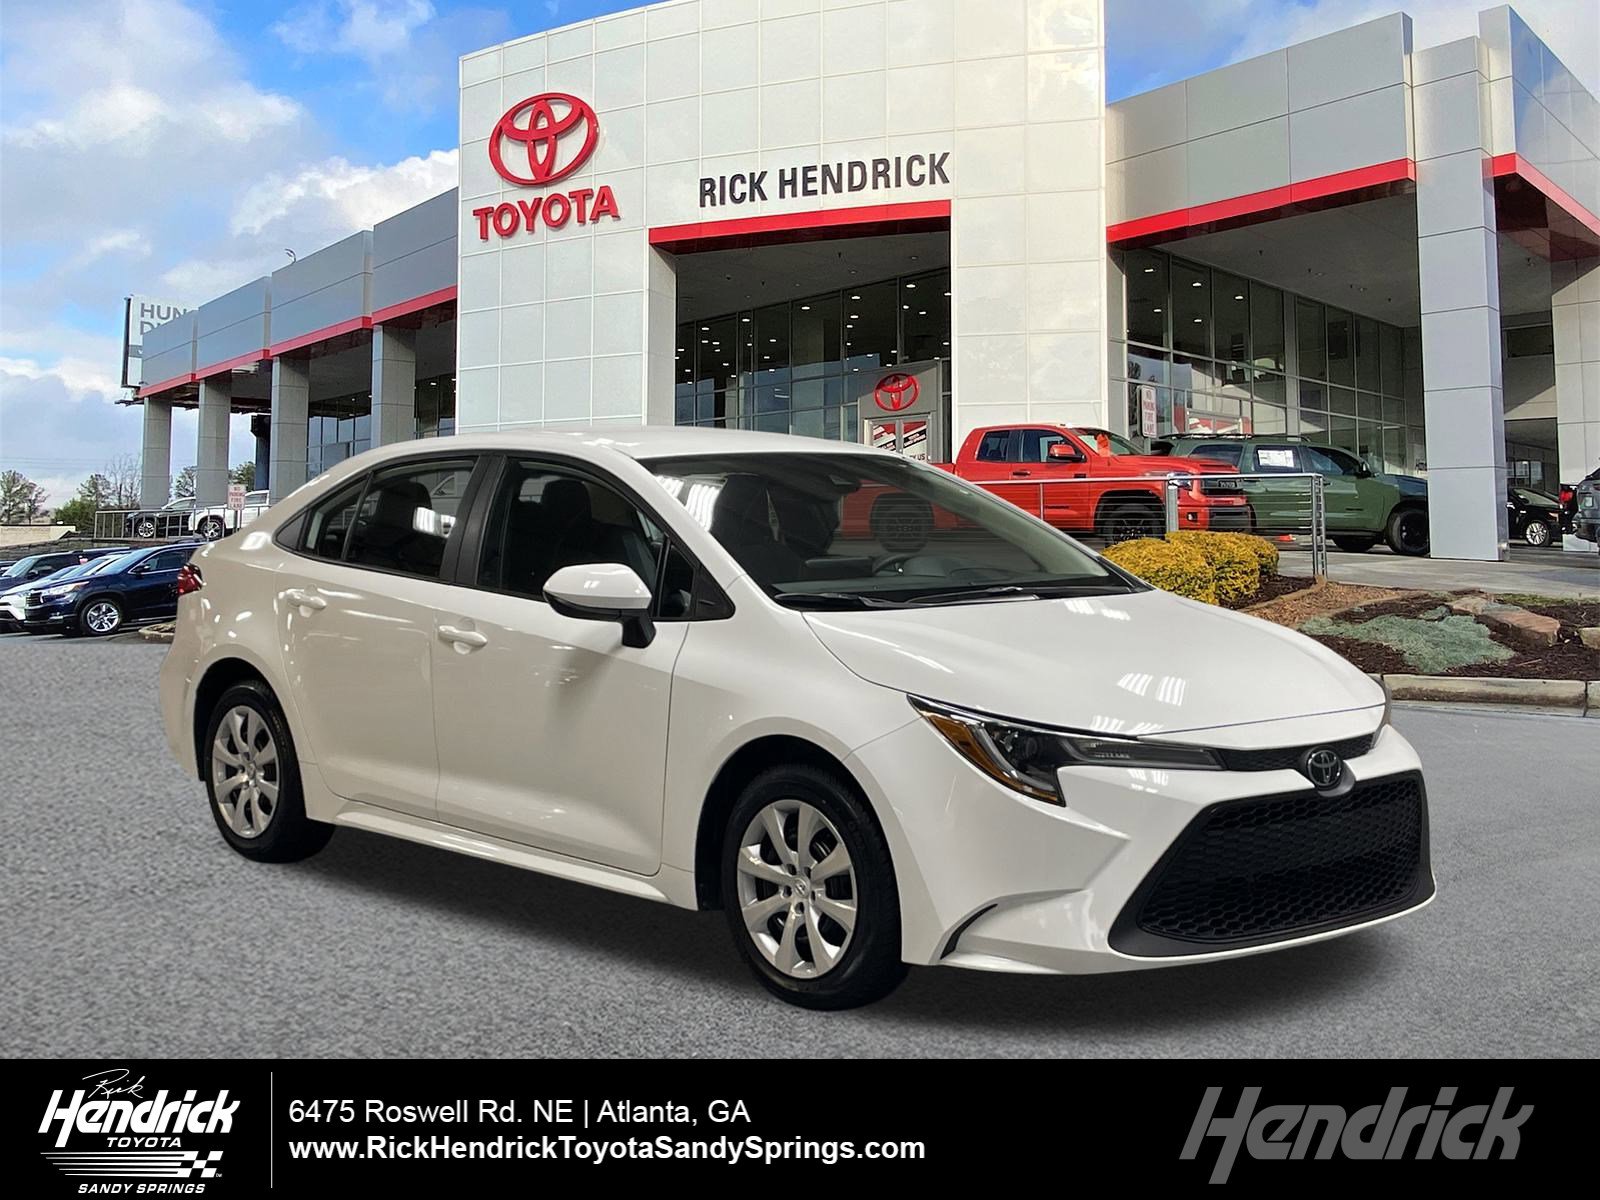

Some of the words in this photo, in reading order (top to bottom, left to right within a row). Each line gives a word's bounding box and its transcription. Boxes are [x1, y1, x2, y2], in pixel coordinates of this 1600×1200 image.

[698, 170, 768, 209] RICK
[778, 151, 951, 200] HENDRICK
[472, 184, 621, 241] TOYOTA
